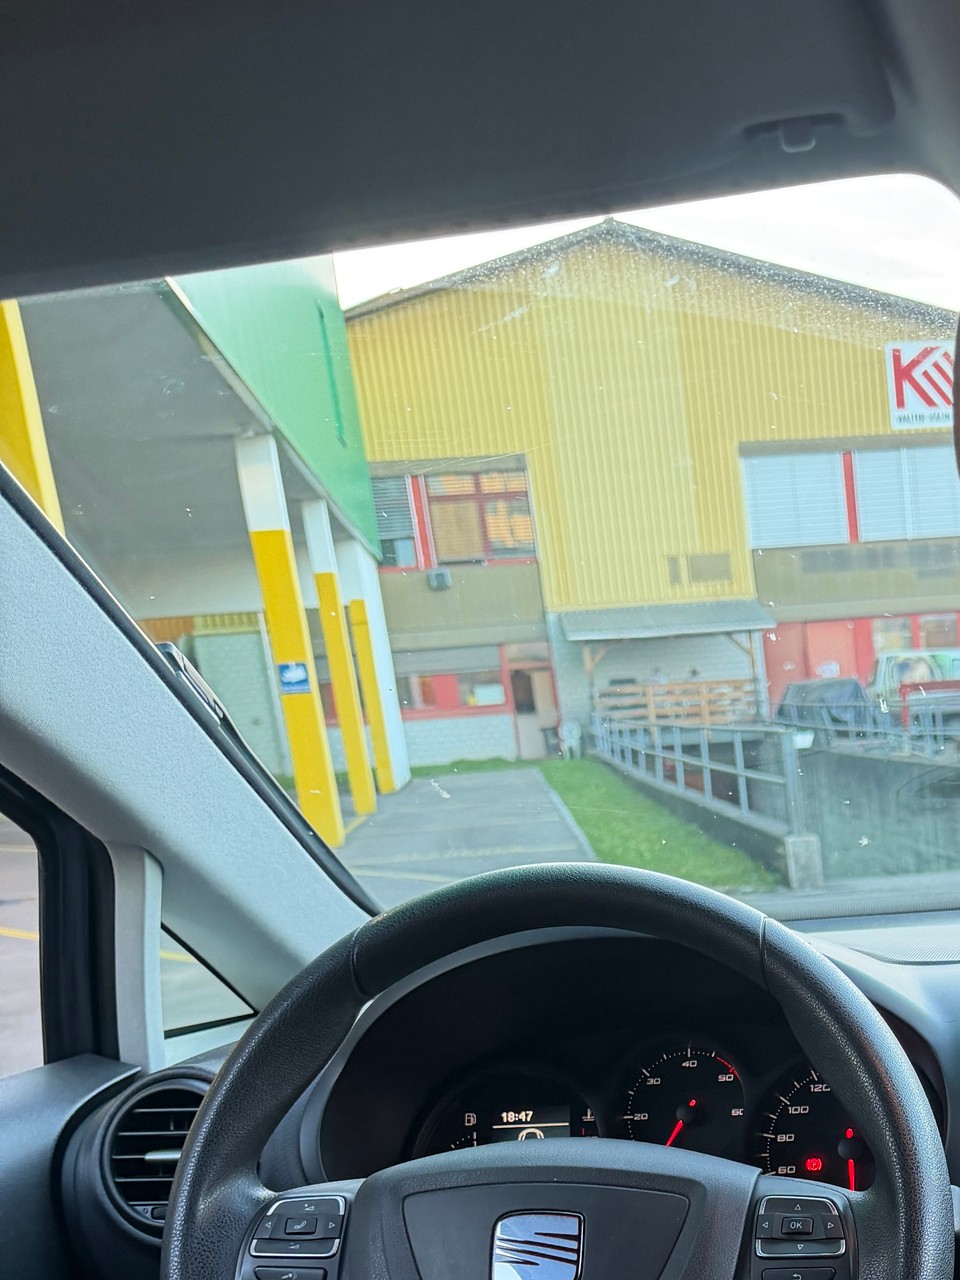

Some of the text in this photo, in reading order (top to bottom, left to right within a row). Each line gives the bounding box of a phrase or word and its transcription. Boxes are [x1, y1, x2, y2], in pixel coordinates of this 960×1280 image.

[788, 1106, 809, 1114] 100
[501, 1111, 533, 1123] 18:47
[777, 1134, 795, 1142] 80
[778, 1166, 796, 1174] 60
[790, 1221, 803, 1229] OK
